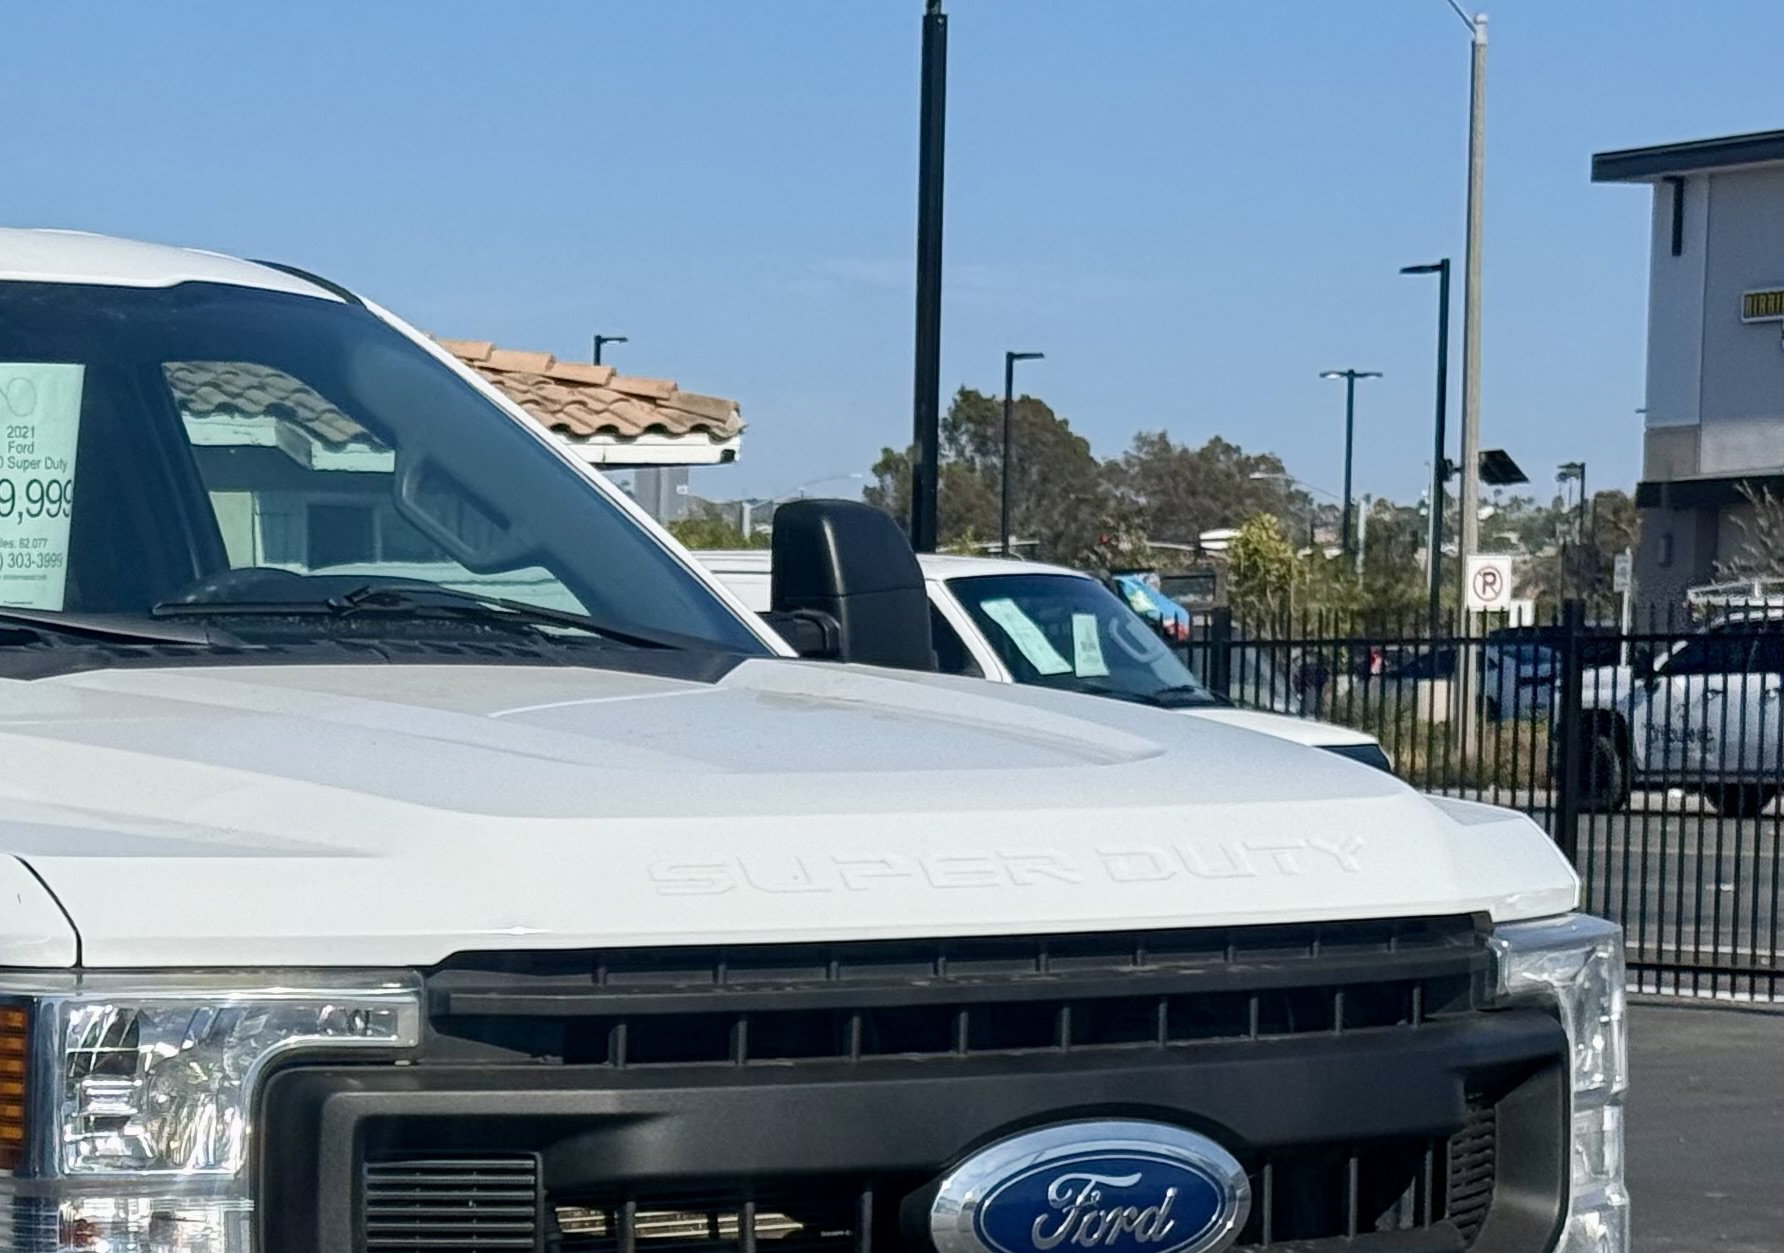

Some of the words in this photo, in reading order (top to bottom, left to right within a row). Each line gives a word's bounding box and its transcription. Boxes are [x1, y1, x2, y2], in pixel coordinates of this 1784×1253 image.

[6, 425, 35, 439] 2021
[7, 441, 35, 454] Ford
[7, 455, 42, 472] Super
[44, 457, 68, 474] Duty
[647, 848, 1084, 897] SUPER
[1092, 835, 1366, 884] DUTY
[1031, 1172, 1178, 1250] Ford
